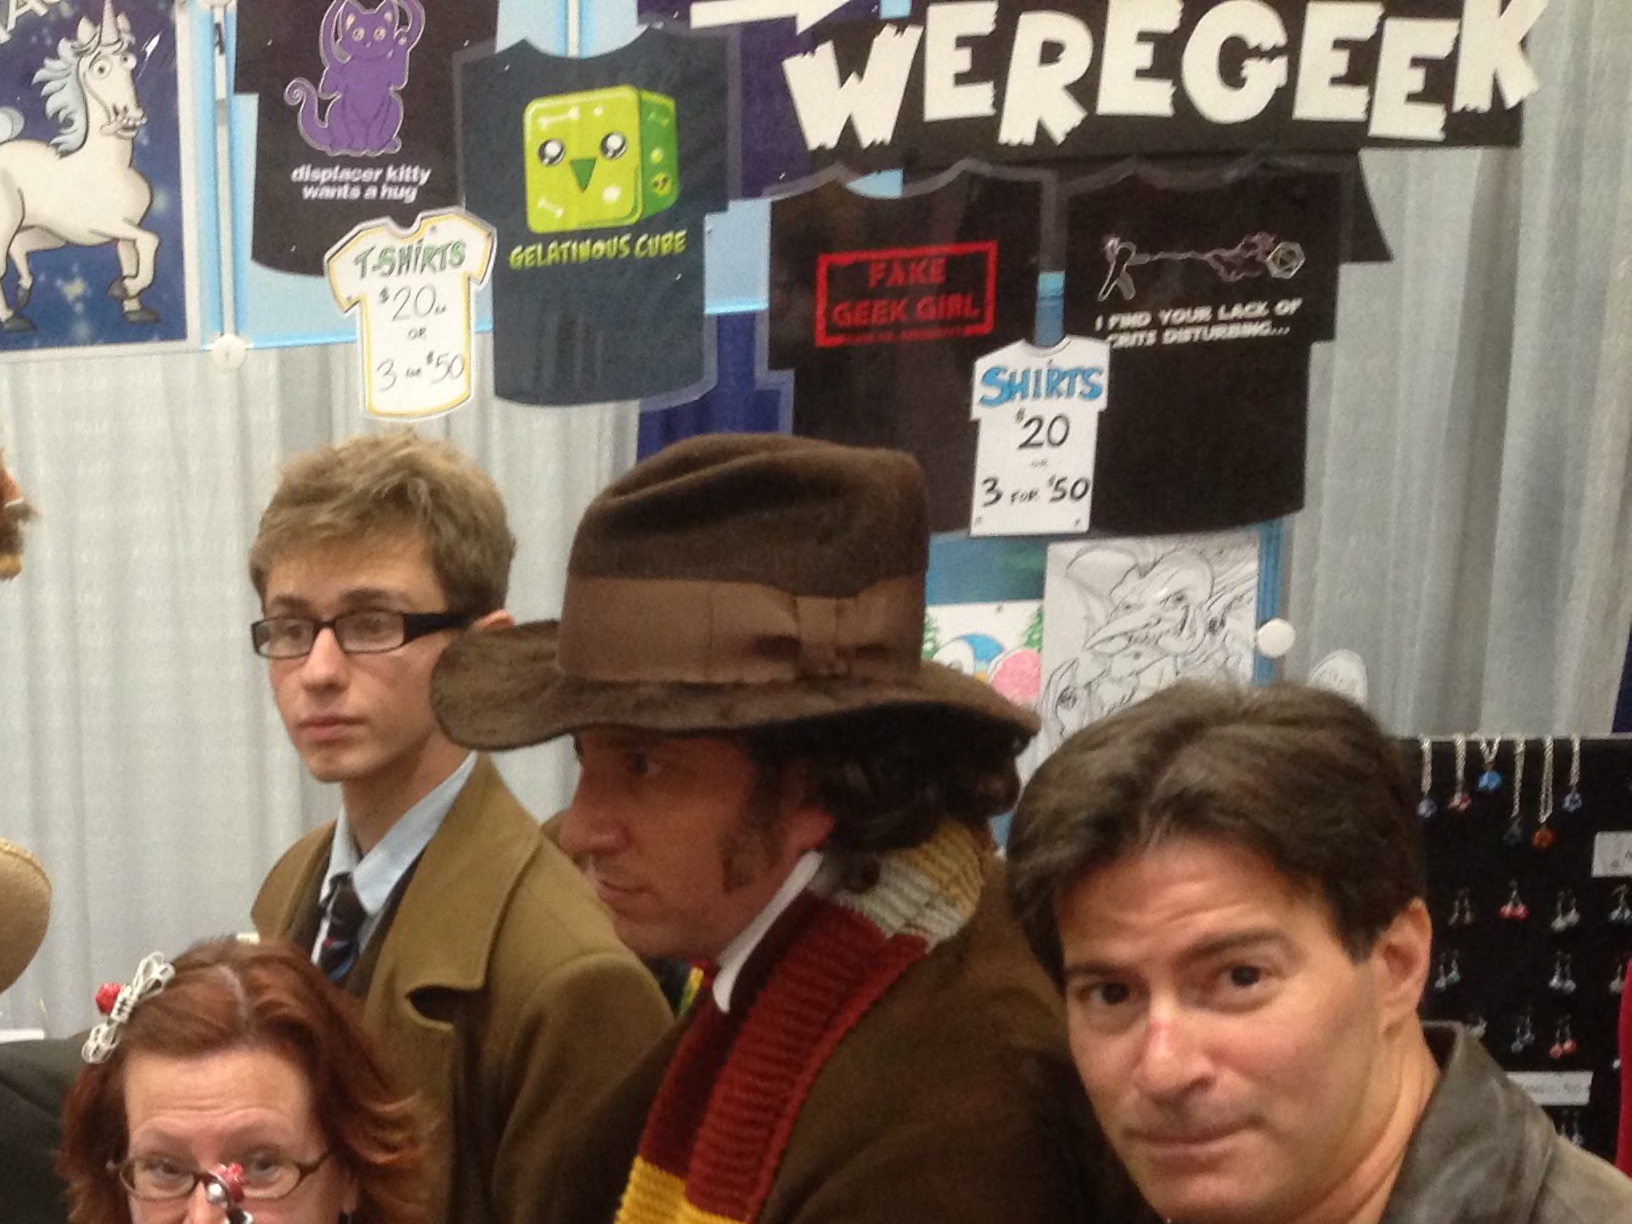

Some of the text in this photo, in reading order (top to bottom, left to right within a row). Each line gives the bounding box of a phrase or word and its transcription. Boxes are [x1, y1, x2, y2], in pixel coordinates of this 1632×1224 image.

[781, 0, 1544, 153] WEREGEEK
[291, 163, 432, 186] displacer kitty
[302, 182, 418, 204] wants a hug
[509, 229, 688, 270] GELATINOUS CUBE
[870, 257, 948, 288] FAKE
[379, 285, 436, 322] $20
[832, 293, 980, 327] GEEK GIRL
[1095, 297, 1303, 331] I FIND YOUR LACK OF
[376, 357, 397, 392] 3
[426, 351, 466, 384] $50
[1016, 408, 1070, 449] $20
[982, 477, 1003, 507] 3
[1048, 474, 1091, 503] $50
